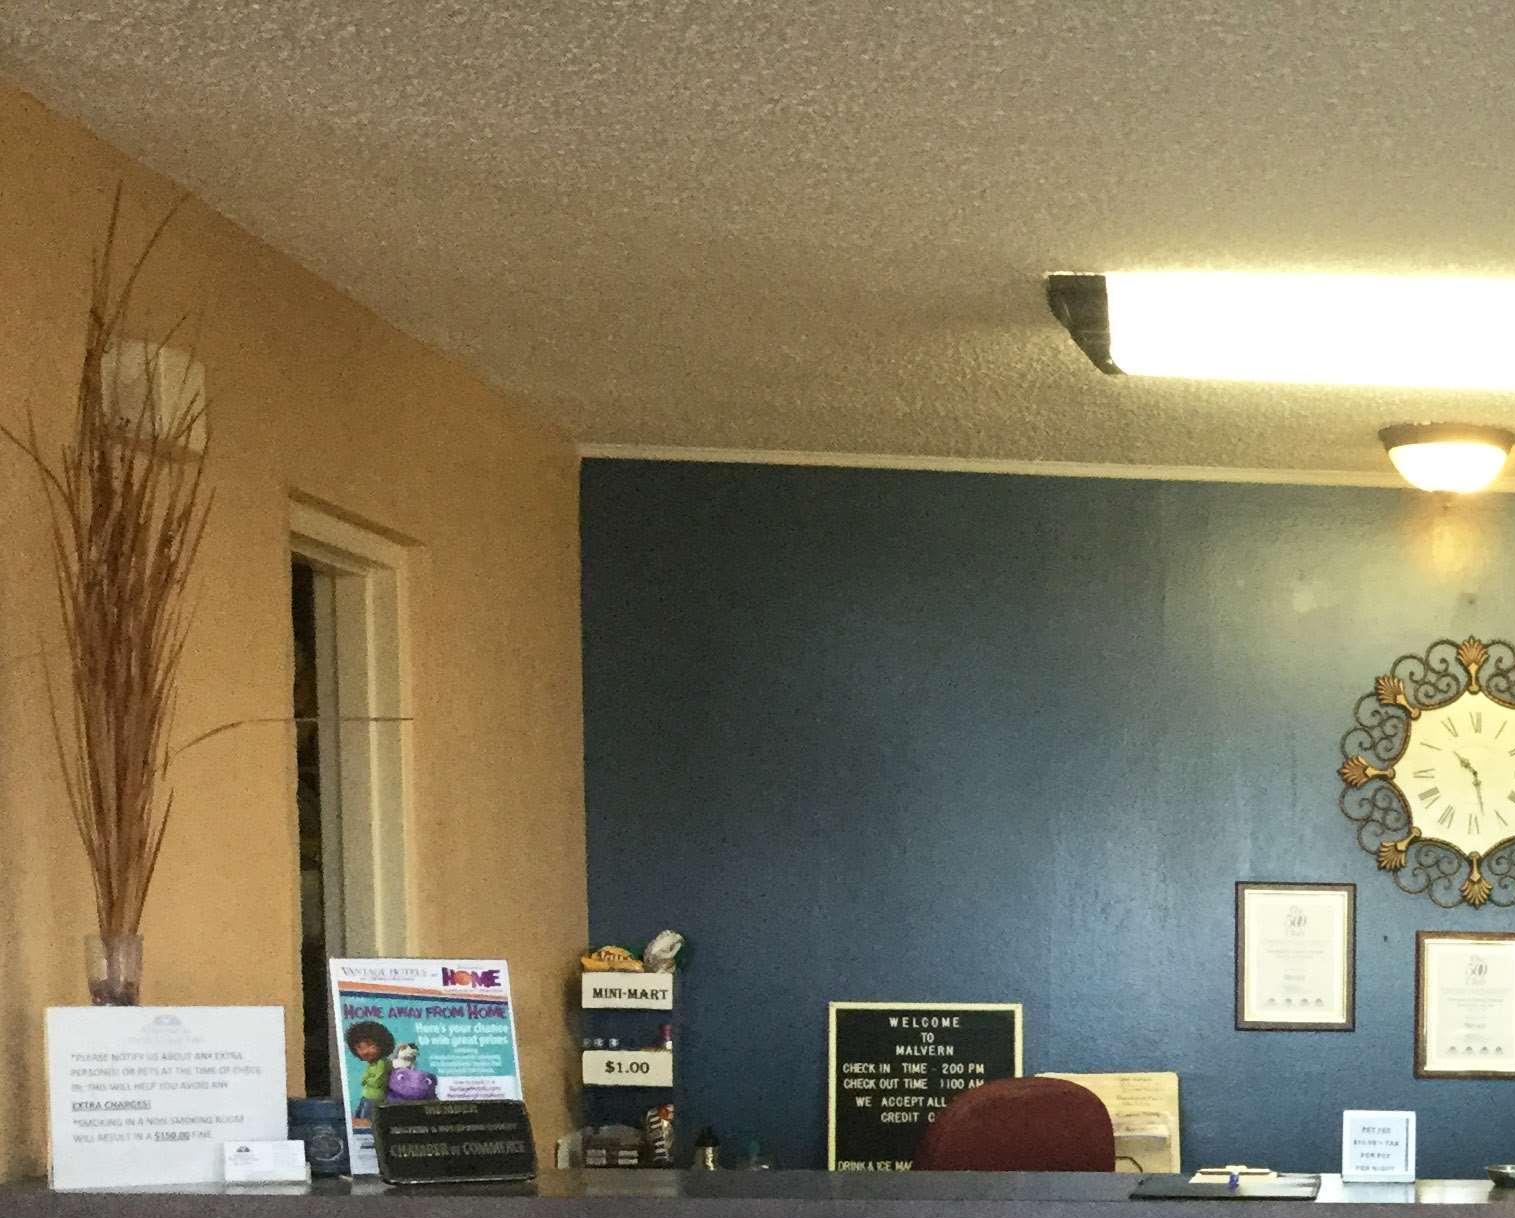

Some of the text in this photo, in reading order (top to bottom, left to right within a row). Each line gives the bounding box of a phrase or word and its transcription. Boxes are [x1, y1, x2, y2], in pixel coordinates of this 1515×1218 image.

[442, 967, 501, 988] HOME
[592, 988, 668, 1000] MINI-MART
[344, 1003, 507, 1020] HOME AWAY FROM HOME
[889, 1017, 960, 1028] WELCOME
[921, 1032, 935, 1043] TO
[896, 1045, 954, 1056] MALVERN
[605, 1061, 650, 1074] $1.00
[842, 1063, 876, 1074] CHECK
[880, 1063, 891, 1074] IN
[902, 1063, 928, 1074] TIME
[942, 1063, 964, 1074] 200
[968, 1063, 985, 1074] PM
[843, 1078, 877, 1089] CHECK
[879, 1078, 899, 1089] OUT
[904, 1078, 928, 1089] TIME
[72, 1101, 101, 1111] EXTRA
[855, 1096, 947, 1107] WE ACCEPT ALL
[880, 1112, 936, 1123] CREDIT C
[391, 1144, 450, 1157] CHAMBER
[463, 1141, 526, 1155] COMMERCE
[838, 1160, 866, 1171] DRINK
[876, 1160, 892, 1171] ICE
